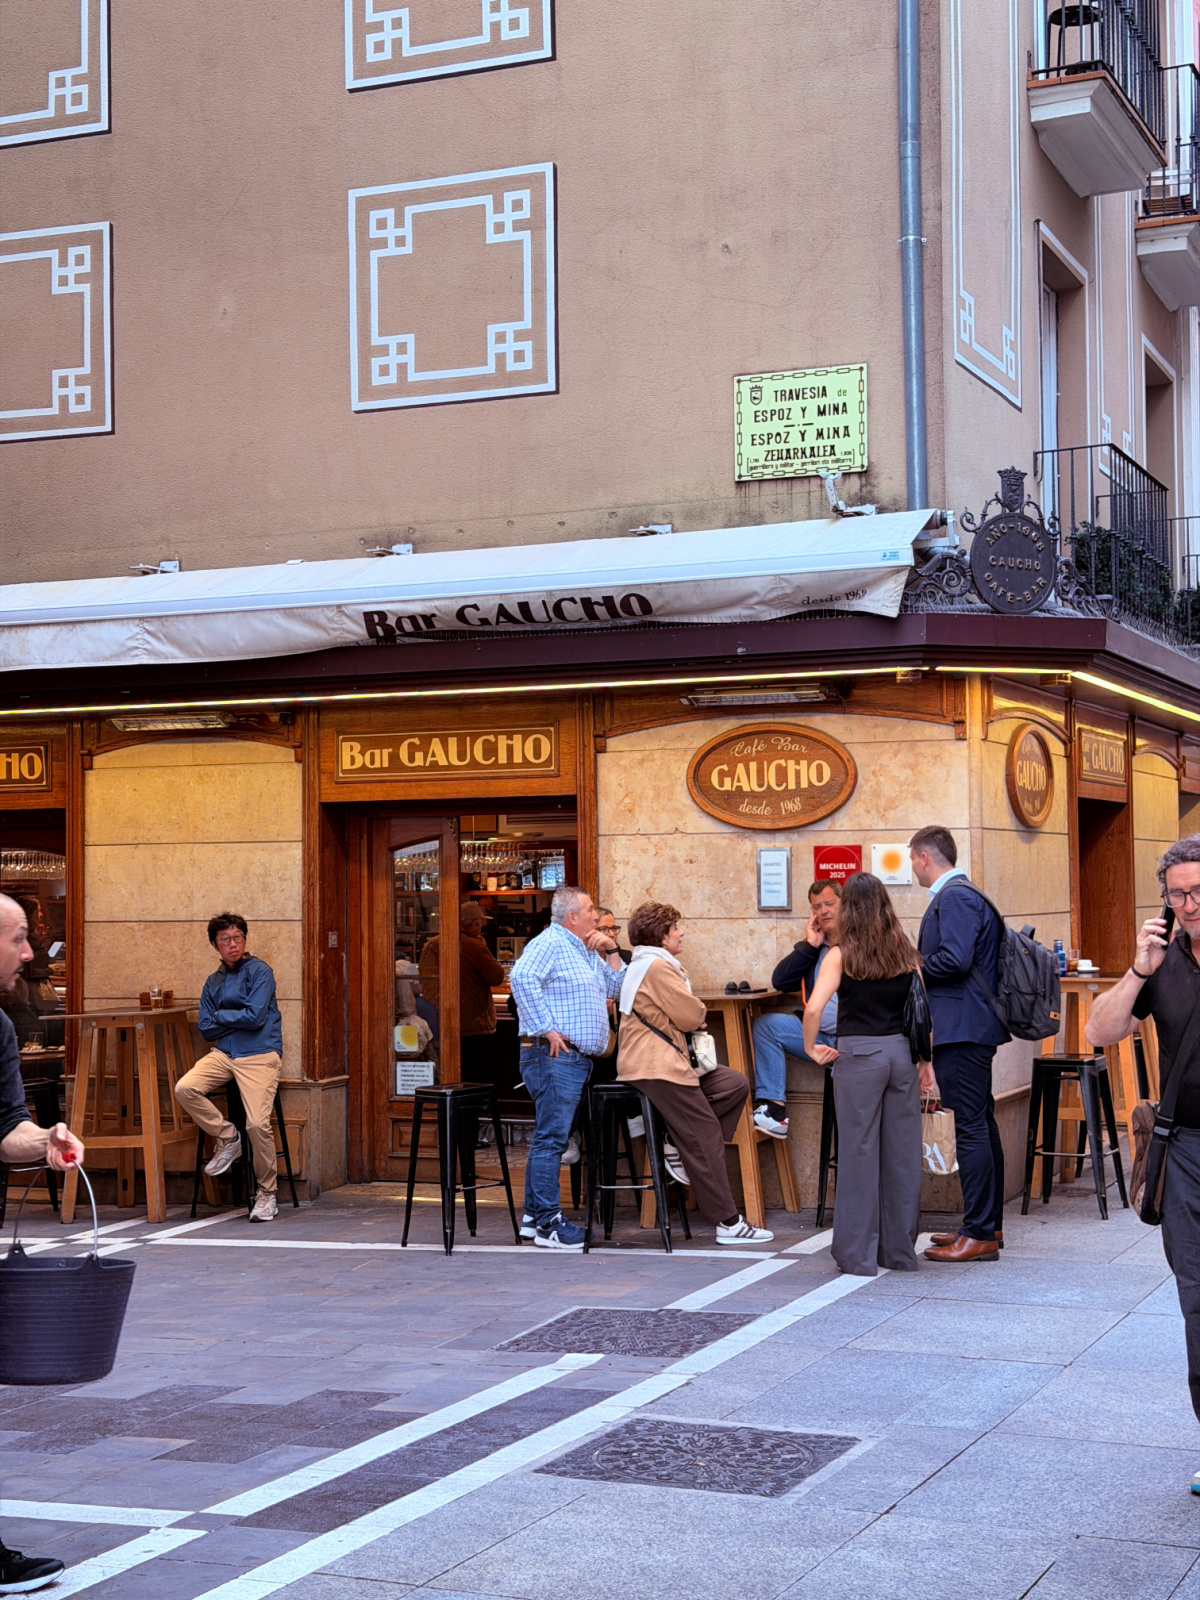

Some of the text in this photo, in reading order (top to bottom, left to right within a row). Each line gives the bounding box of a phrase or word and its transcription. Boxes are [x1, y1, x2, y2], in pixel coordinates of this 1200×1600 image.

[773, 385, 847, 402] TRAVESIA de
[754, 402, 848, 423] ESPOZ Y MINA
[751, 425, 850, 446] ESPOZ Y MINA
[802, 595, 841, 606] desde
[362, 592, 653, 639] Bar GAUCHO
[342, 733, 551, 770] Bar GAUCHO
[730, 736, 808, 757] Café Bar
[1092, 742, 1124, 774] GAUCHO
[711, 758, 831, 792] GAUCHO
[1016, 760, 1046, 791] GAUCHO
[738, 797, 802, 815] desde 1968
[829, 871, 846, 879] 2025
